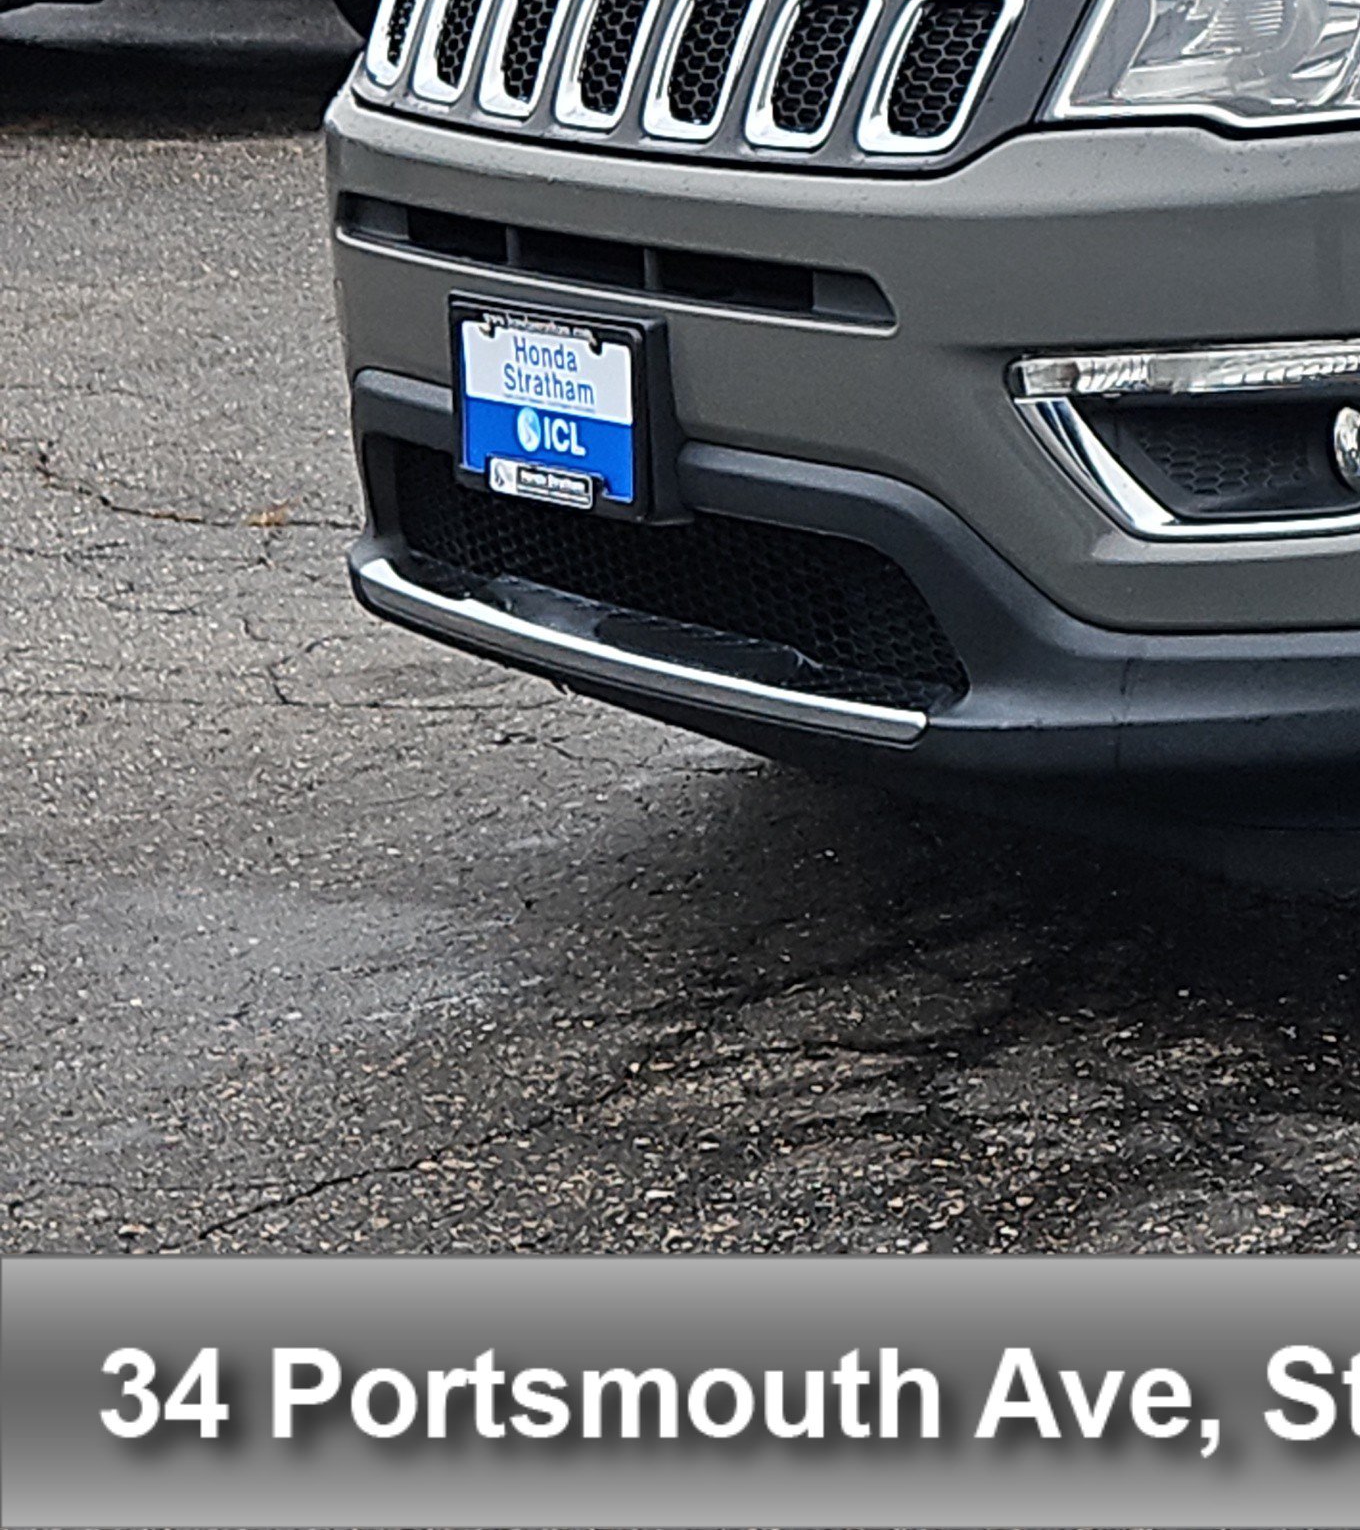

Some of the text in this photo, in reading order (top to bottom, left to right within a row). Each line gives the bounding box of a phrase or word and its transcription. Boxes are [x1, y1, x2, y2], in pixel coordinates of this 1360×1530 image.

[513, 335, 578, 373] Honda
[503, 363, 595, 406] Stratham
[543, 416, 587, 457] ICL
